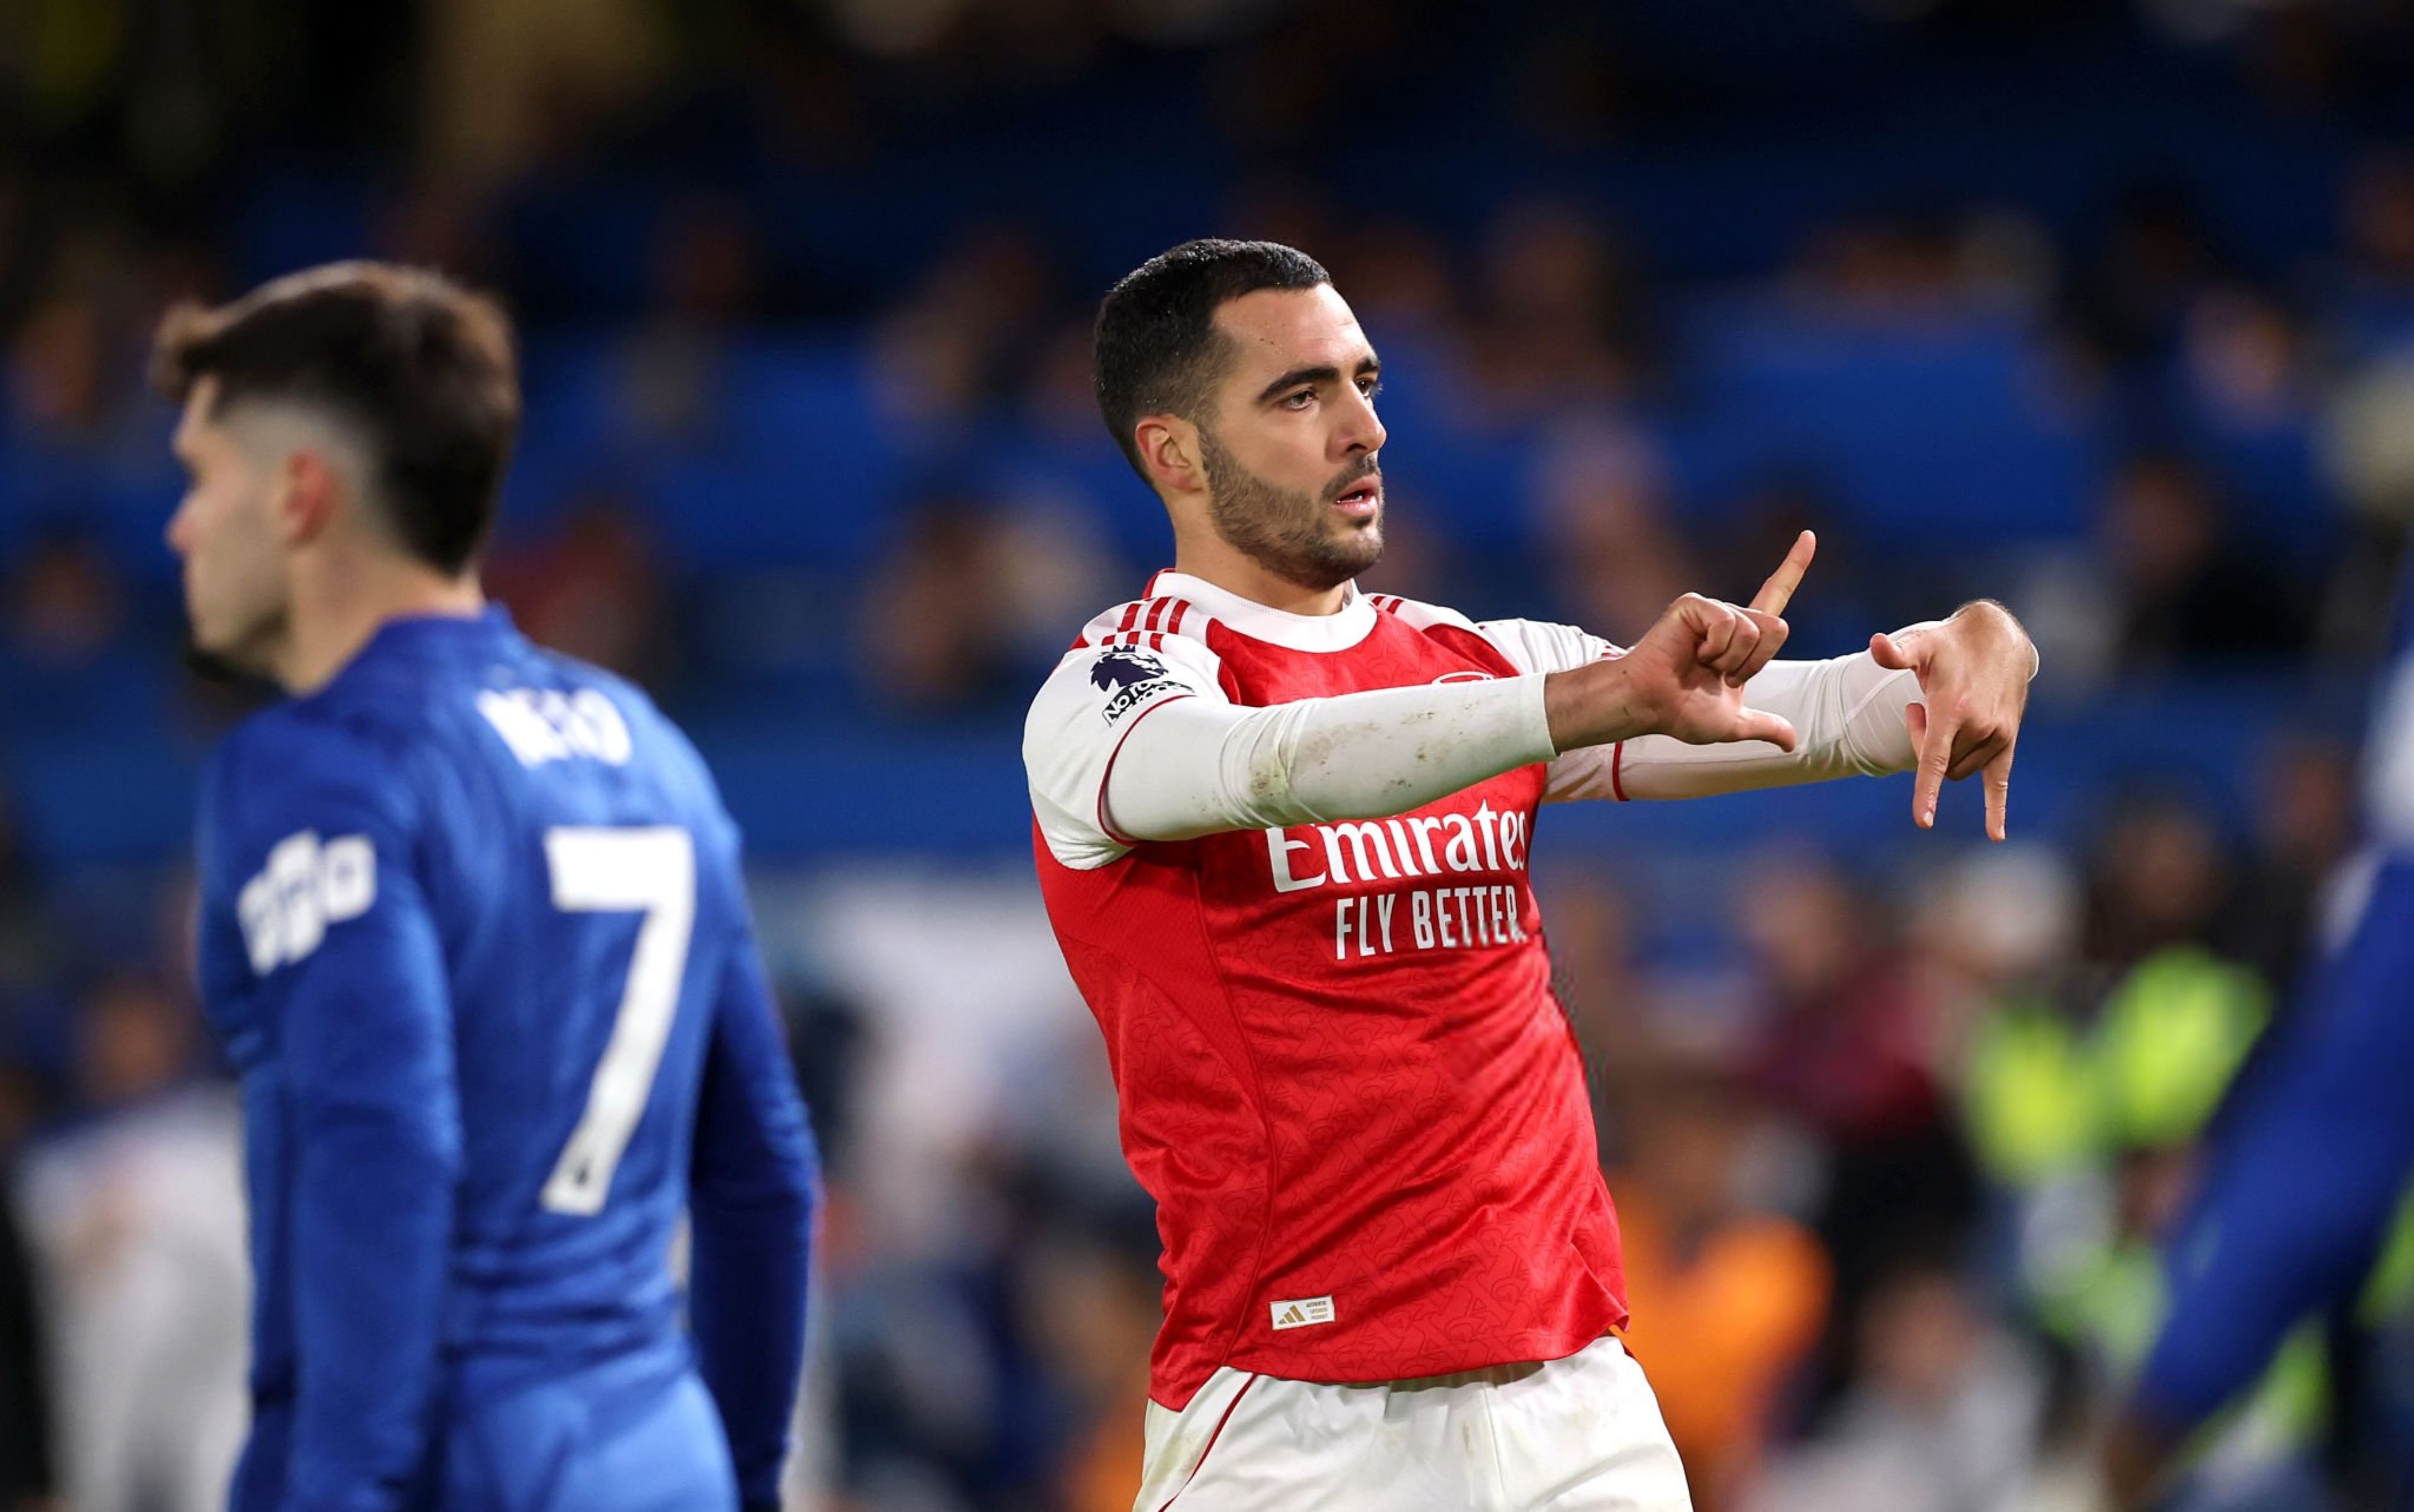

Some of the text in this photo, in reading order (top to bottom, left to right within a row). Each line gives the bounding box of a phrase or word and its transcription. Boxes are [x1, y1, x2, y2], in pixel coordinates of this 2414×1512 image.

[1265, 798, 1526, 893] Emirates
[1336, 886, 1528, 960] FLY BETTER
[542, 824, 695, 1215] 7
